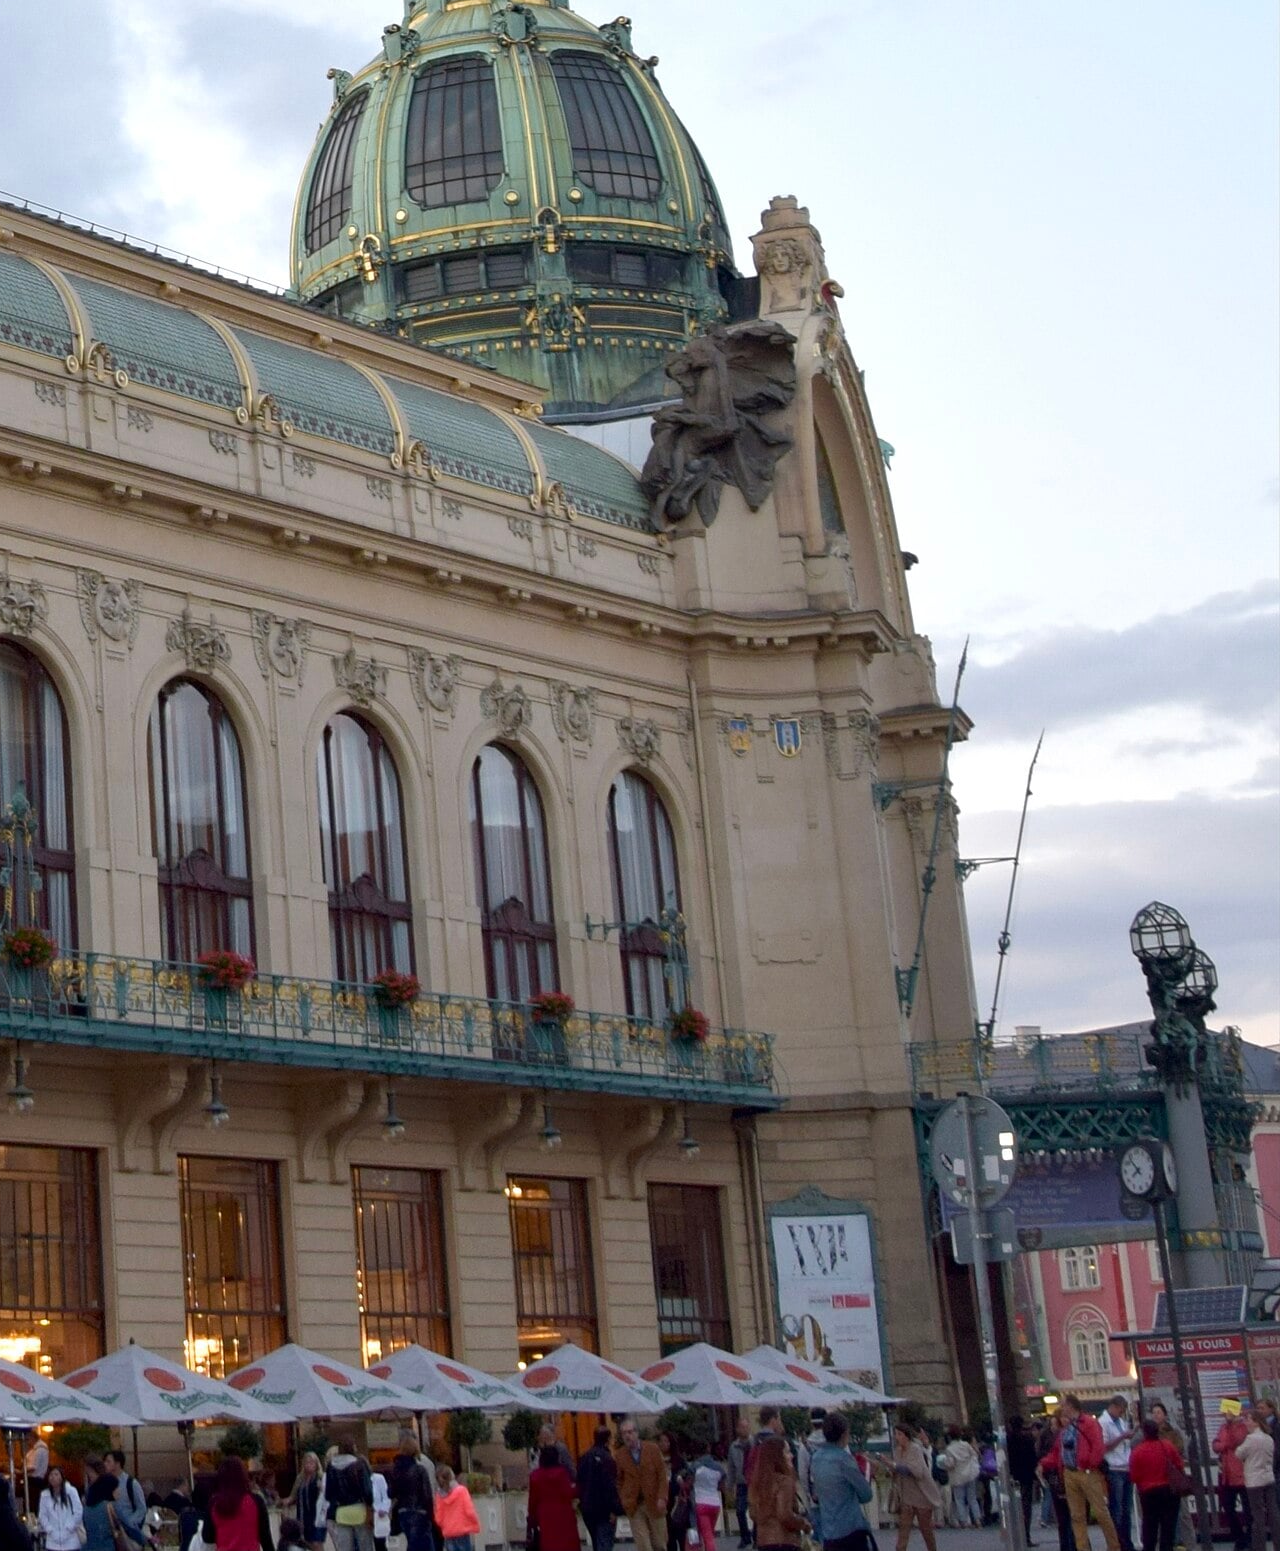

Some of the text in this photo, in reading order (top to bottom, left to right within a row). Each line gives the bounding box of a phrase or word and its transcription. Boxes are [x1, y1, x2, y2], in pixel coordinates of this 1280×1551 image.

[1146, 1338, 1232, 1353] WALKNG TOURS
[555, 1385, 602, 1401] Urquell
